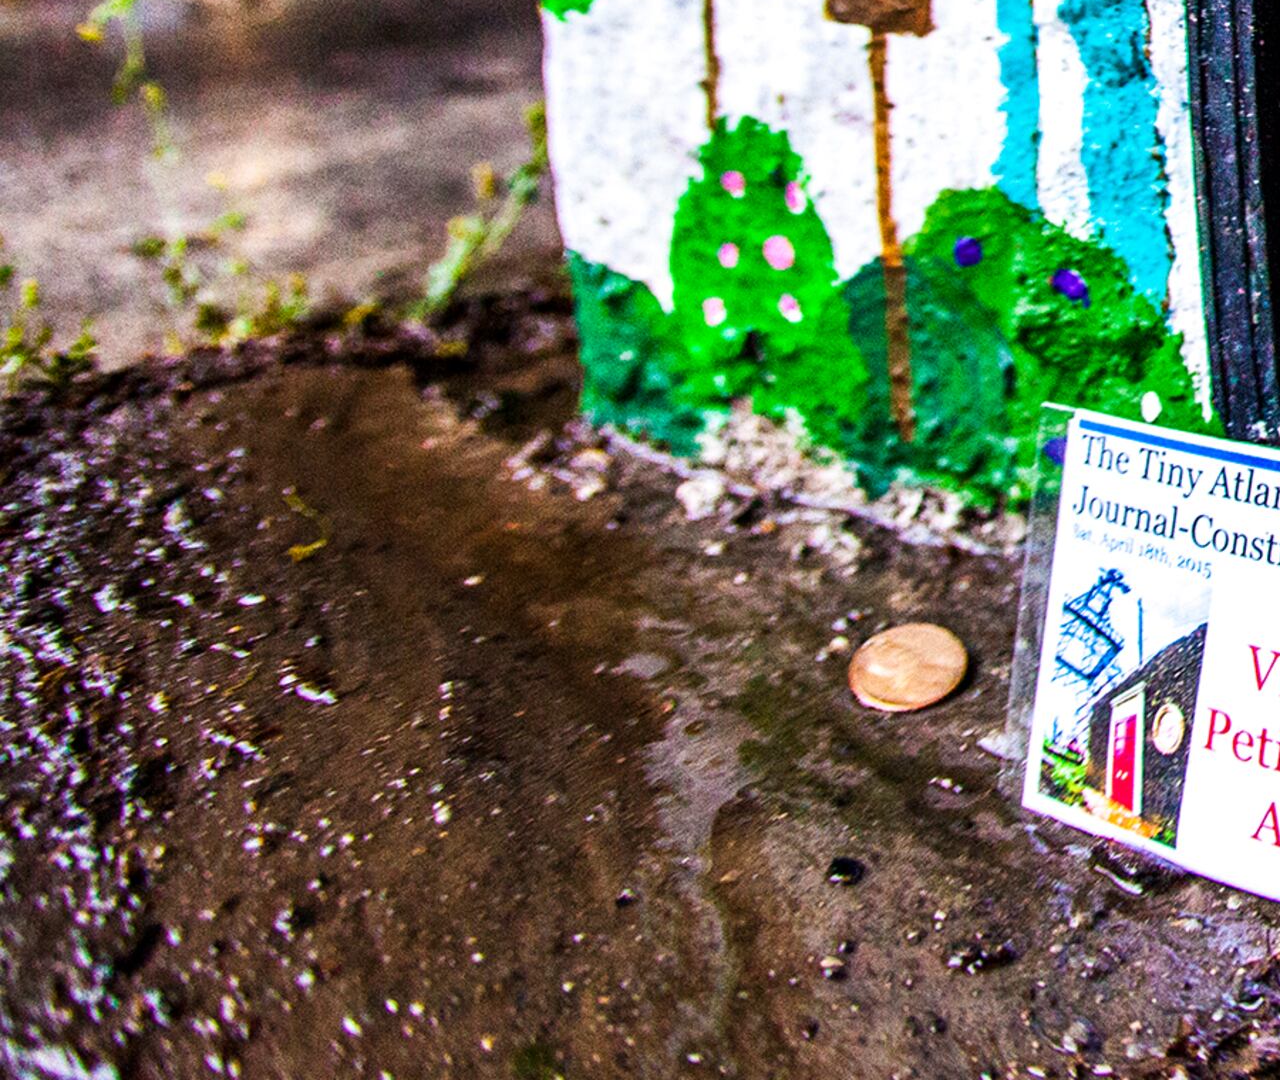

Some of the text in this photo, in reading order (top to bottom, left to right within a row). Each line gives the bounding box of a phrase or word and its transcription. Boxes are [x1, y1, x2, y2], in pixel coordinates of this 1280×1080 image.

[1082, 434, 1130, 474] The
[1139, 447, 1203, 498] Tiny
[1101, 532, 1134, 556] April
[1138, 543, 1172, 568] 18th,
[1177, 555, 1212, 580] 2015
